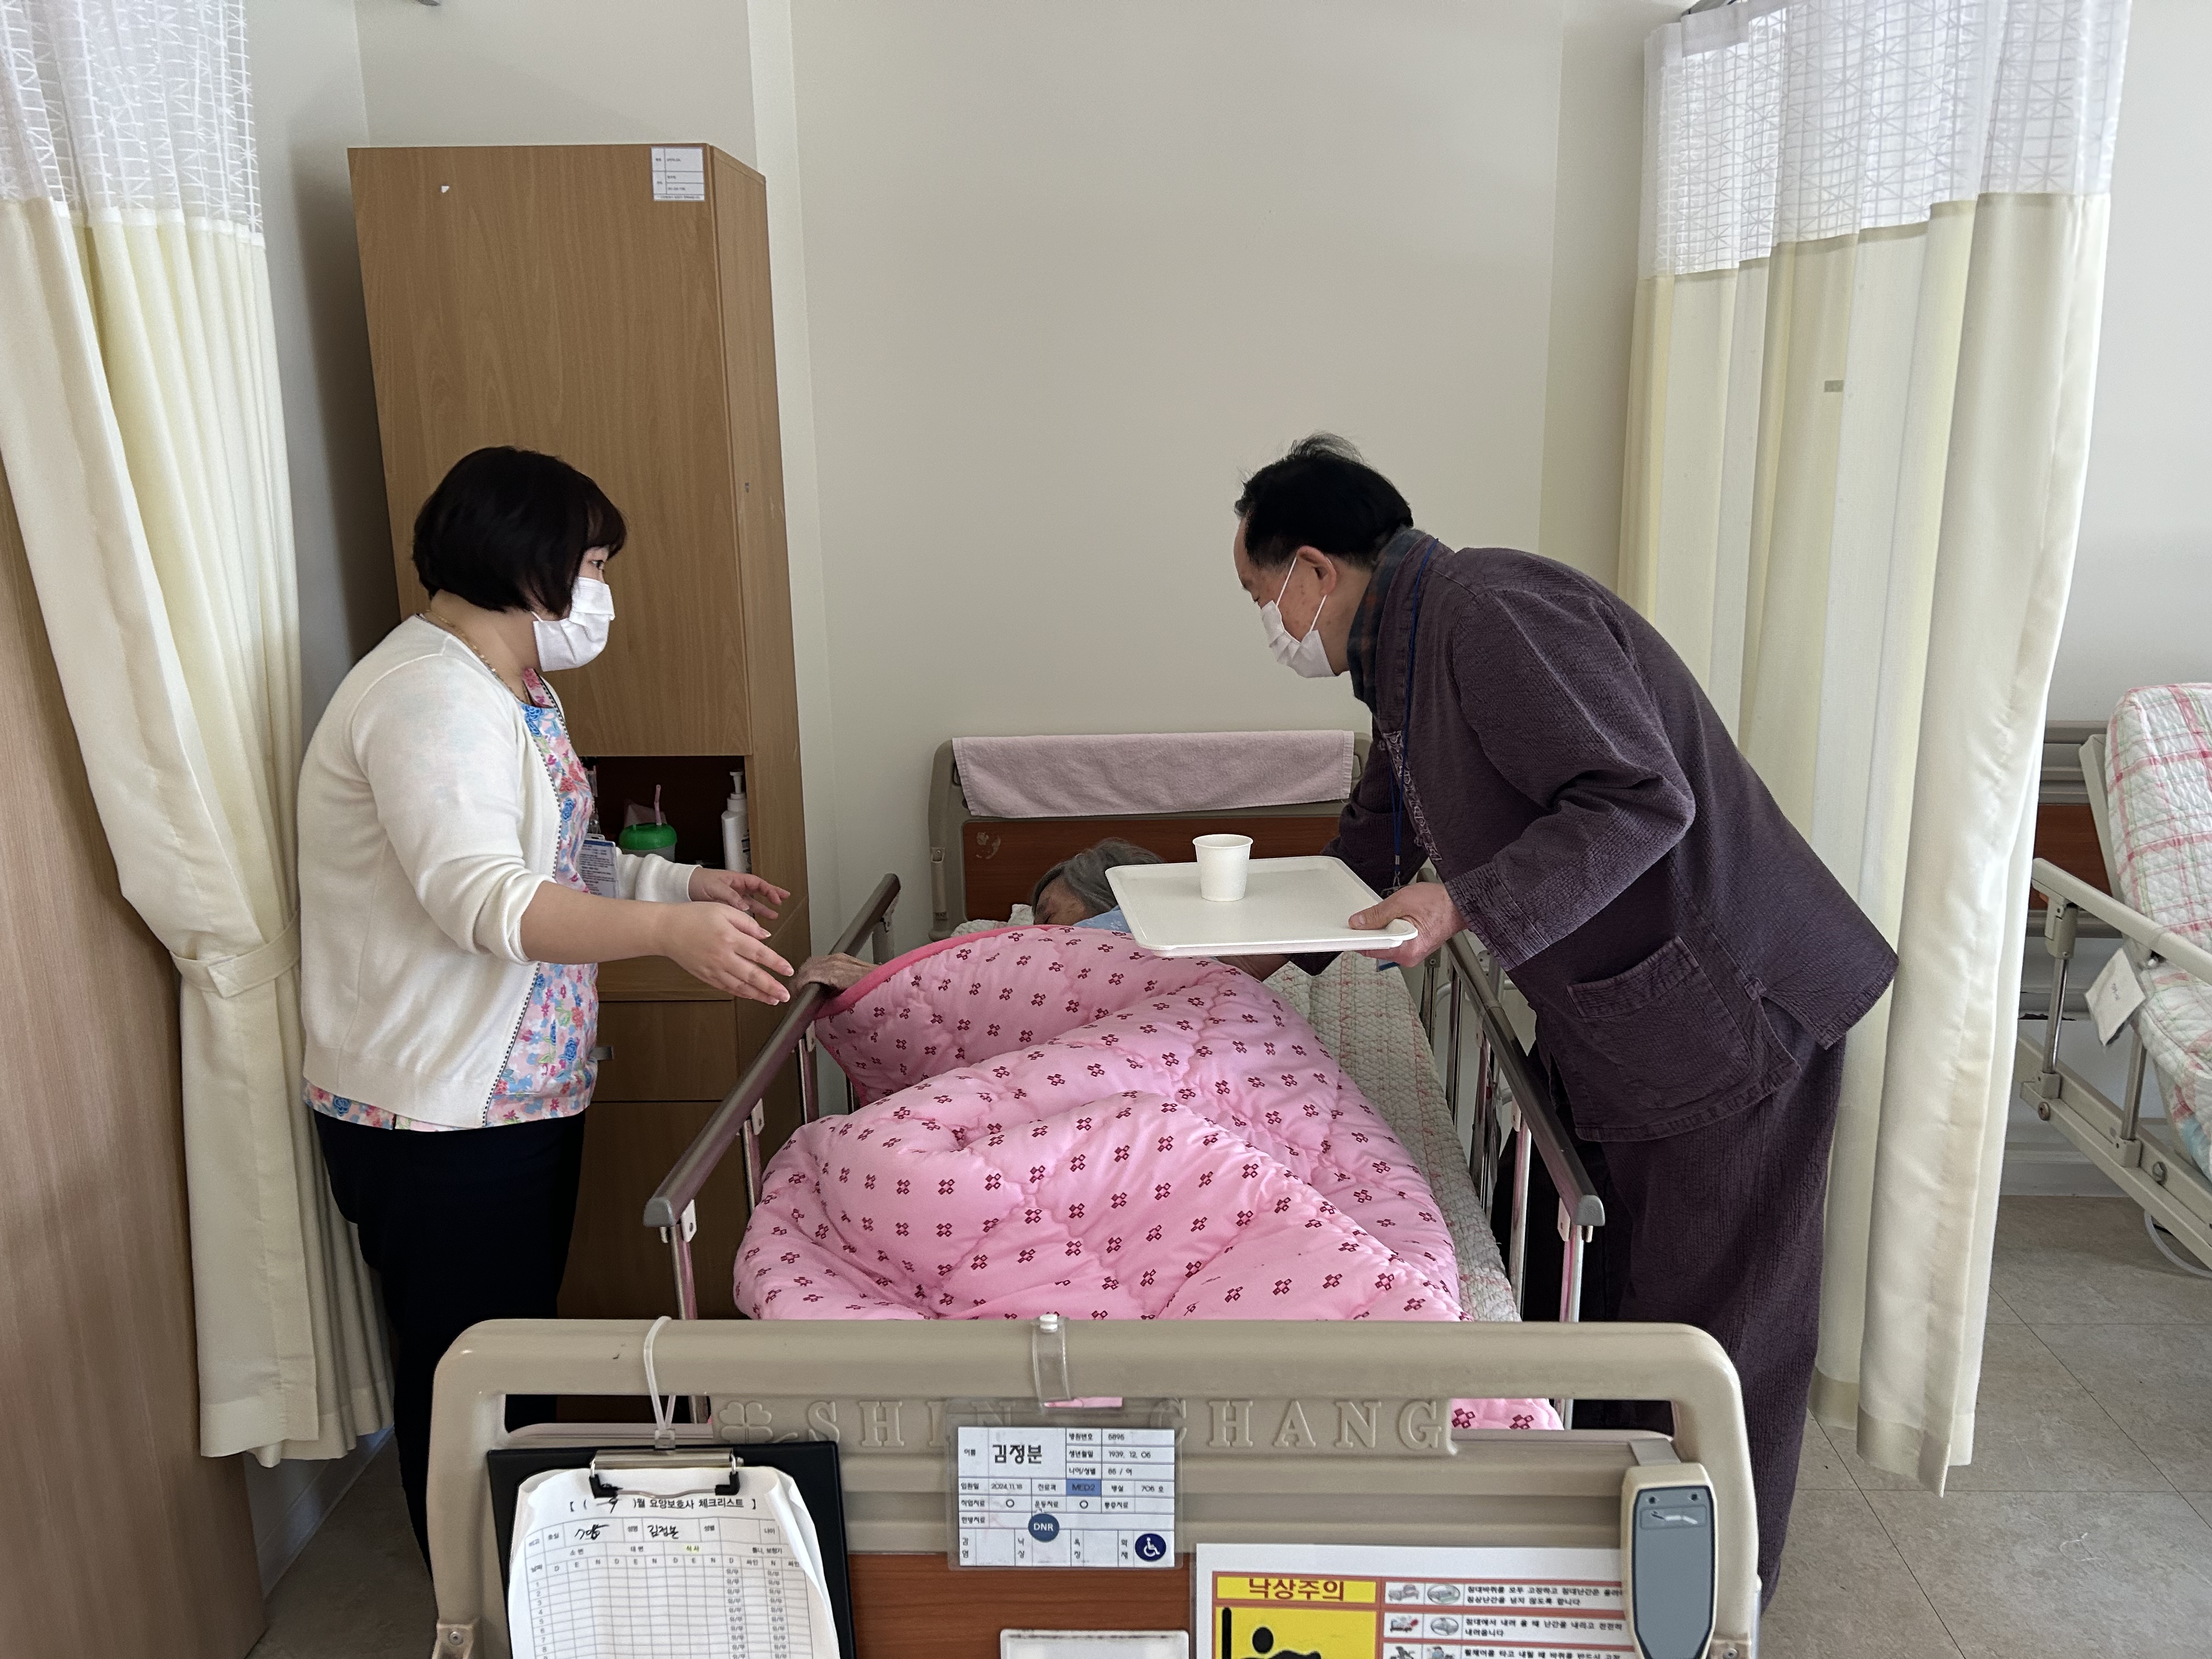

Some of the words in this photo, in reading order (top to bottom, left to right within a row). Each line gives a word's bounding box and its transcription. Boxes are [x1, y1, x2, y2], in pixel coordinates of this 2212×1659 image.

[964, 1448, 976, 1457] 이름
[992, 1444, 1042, 1464] 김정분
[1069, 1450, 1093, 1458] 생년월일
[1071, 1483, 1096, 1492] MED2
[650, 1498, 694, 1509] 요양보호사
[698, 1498, 744, 1509] 체크리스트
[1033, 1522, 1054, 1532] DNR
[1249, 1578, 1344, 1601] 낙상주의
[1557, 1598, 1581, 1606] 합니다
